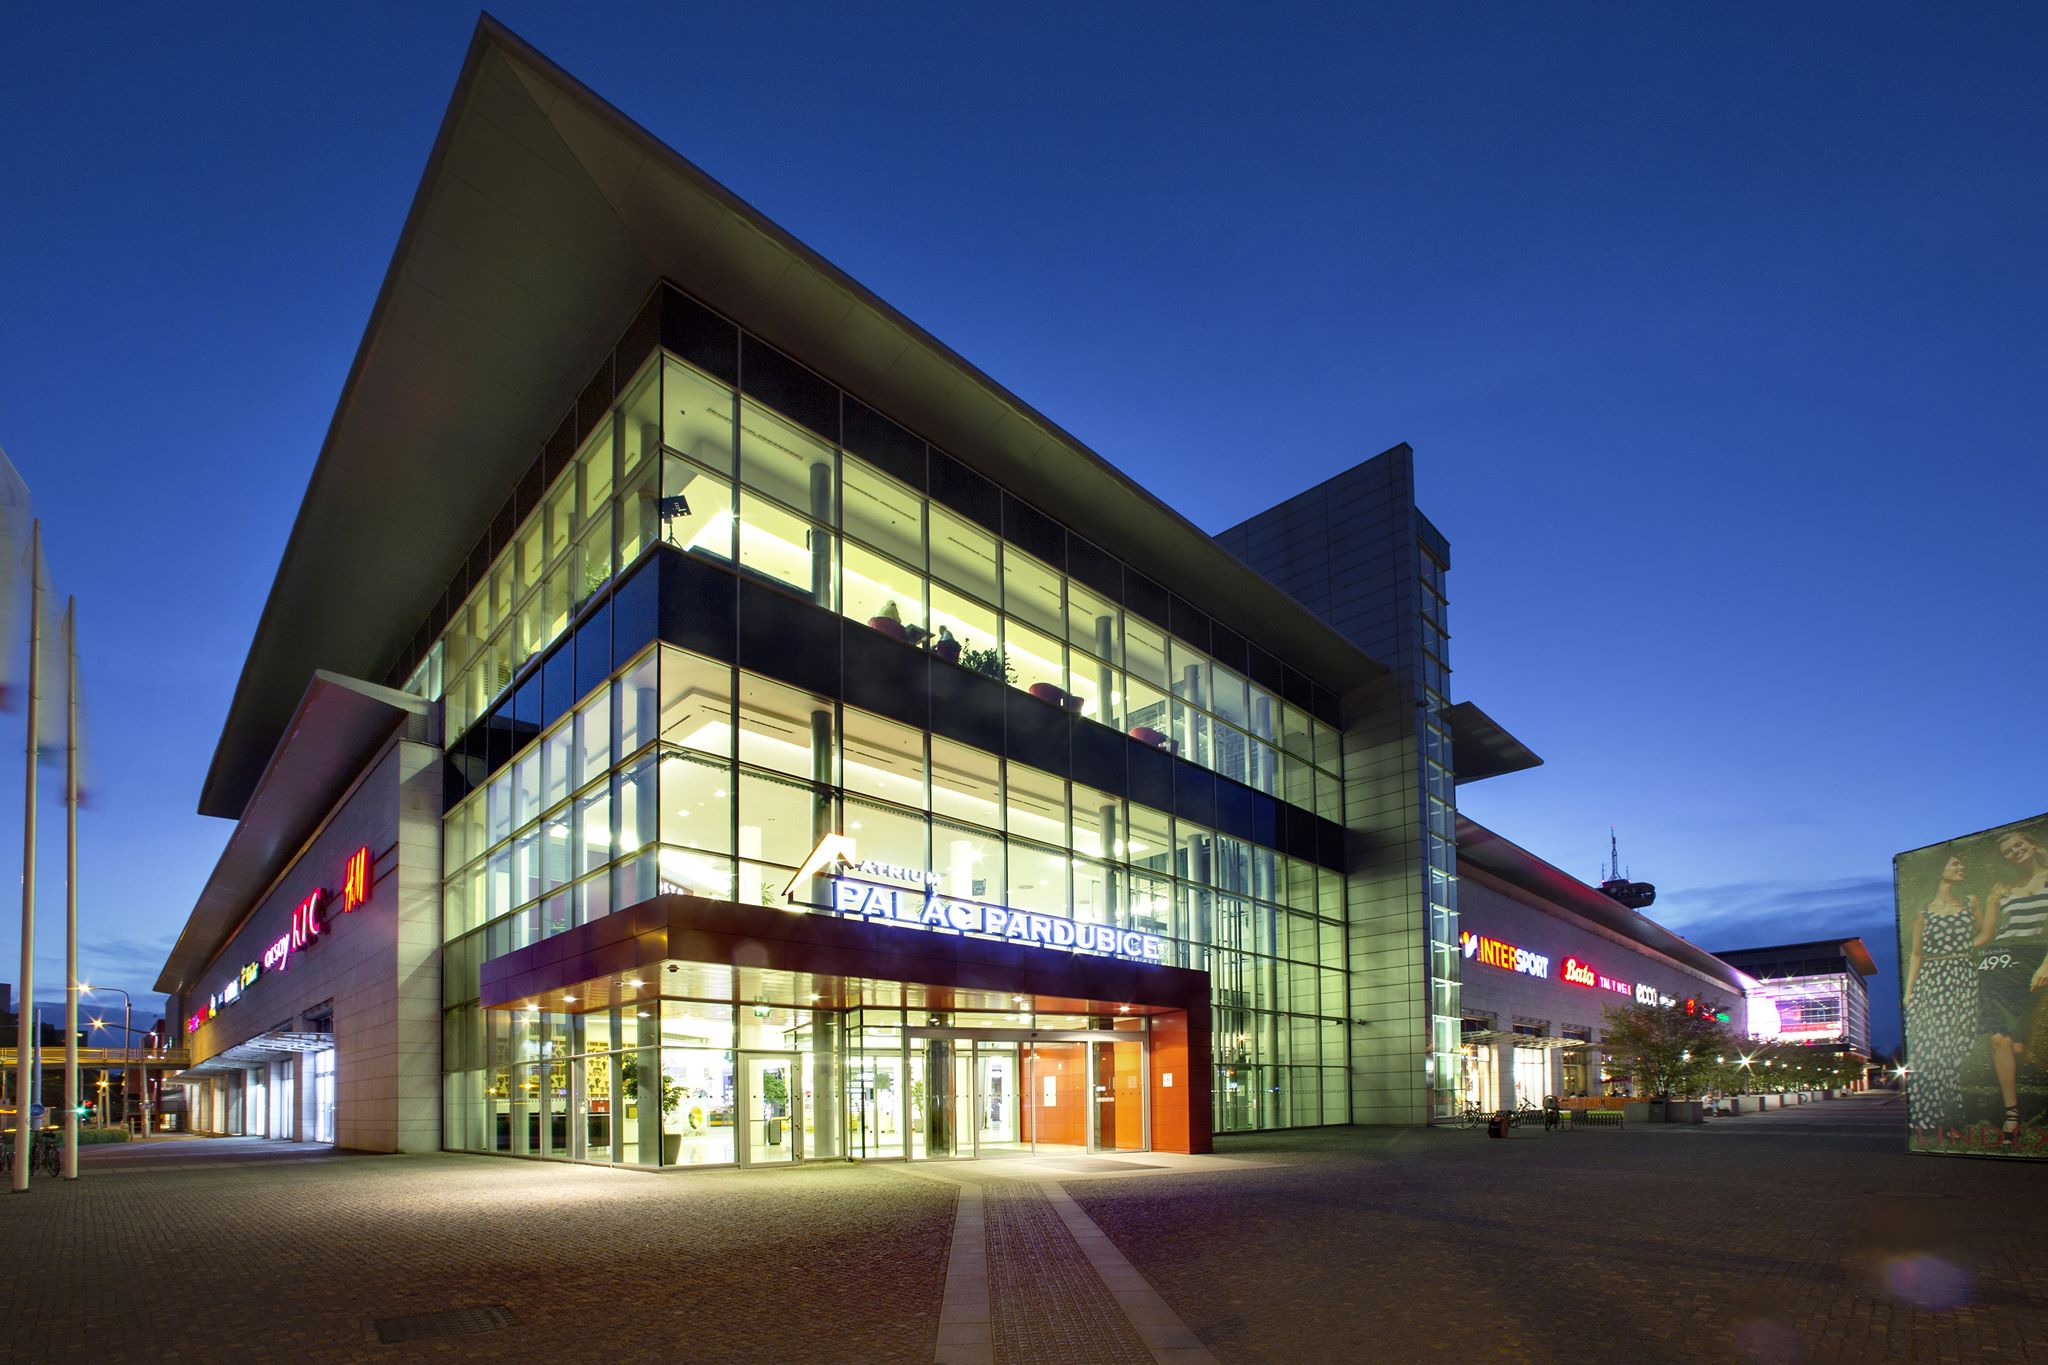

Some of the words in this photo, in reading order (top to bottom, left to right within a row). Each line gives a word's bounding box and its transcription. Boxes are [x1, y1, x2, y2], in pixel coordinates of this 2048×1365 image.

[857, 859, 942, 887] ATRIUM
[832, 879, 978, 931] PALÁC
[981, 906, 1161, 960] PARDUBICE
[1478, 935, 1549, 979] INTERSPORT
[1564, 957, 1596, 988] Bata
[1977, 953, 2020, 971] 499.-
